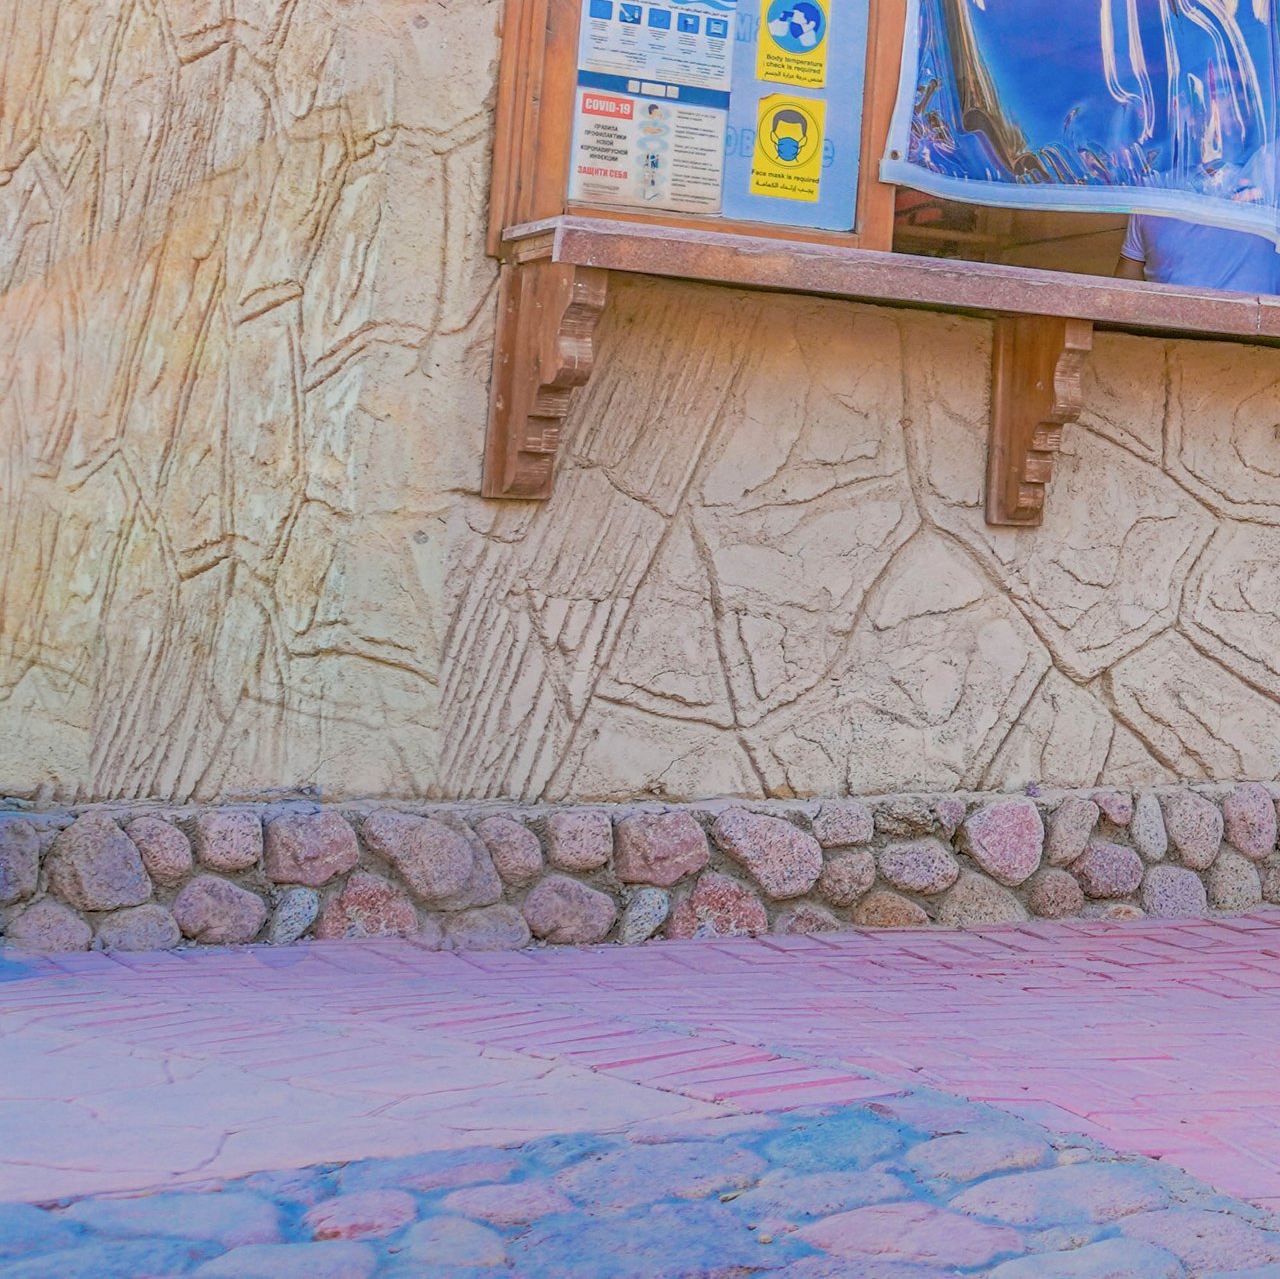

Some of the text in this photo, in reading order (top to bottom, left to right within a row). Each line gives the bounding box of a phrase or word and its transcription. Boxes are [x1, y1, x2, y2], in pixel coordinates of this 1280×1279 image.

[767, 54, 823, 67] Body temperature
[585, 98, 630, 115] COVID-19
[577, 165, 628, 179] ЗАЩИТИ СЕБЯ
[793, 176, 819, 184] required
